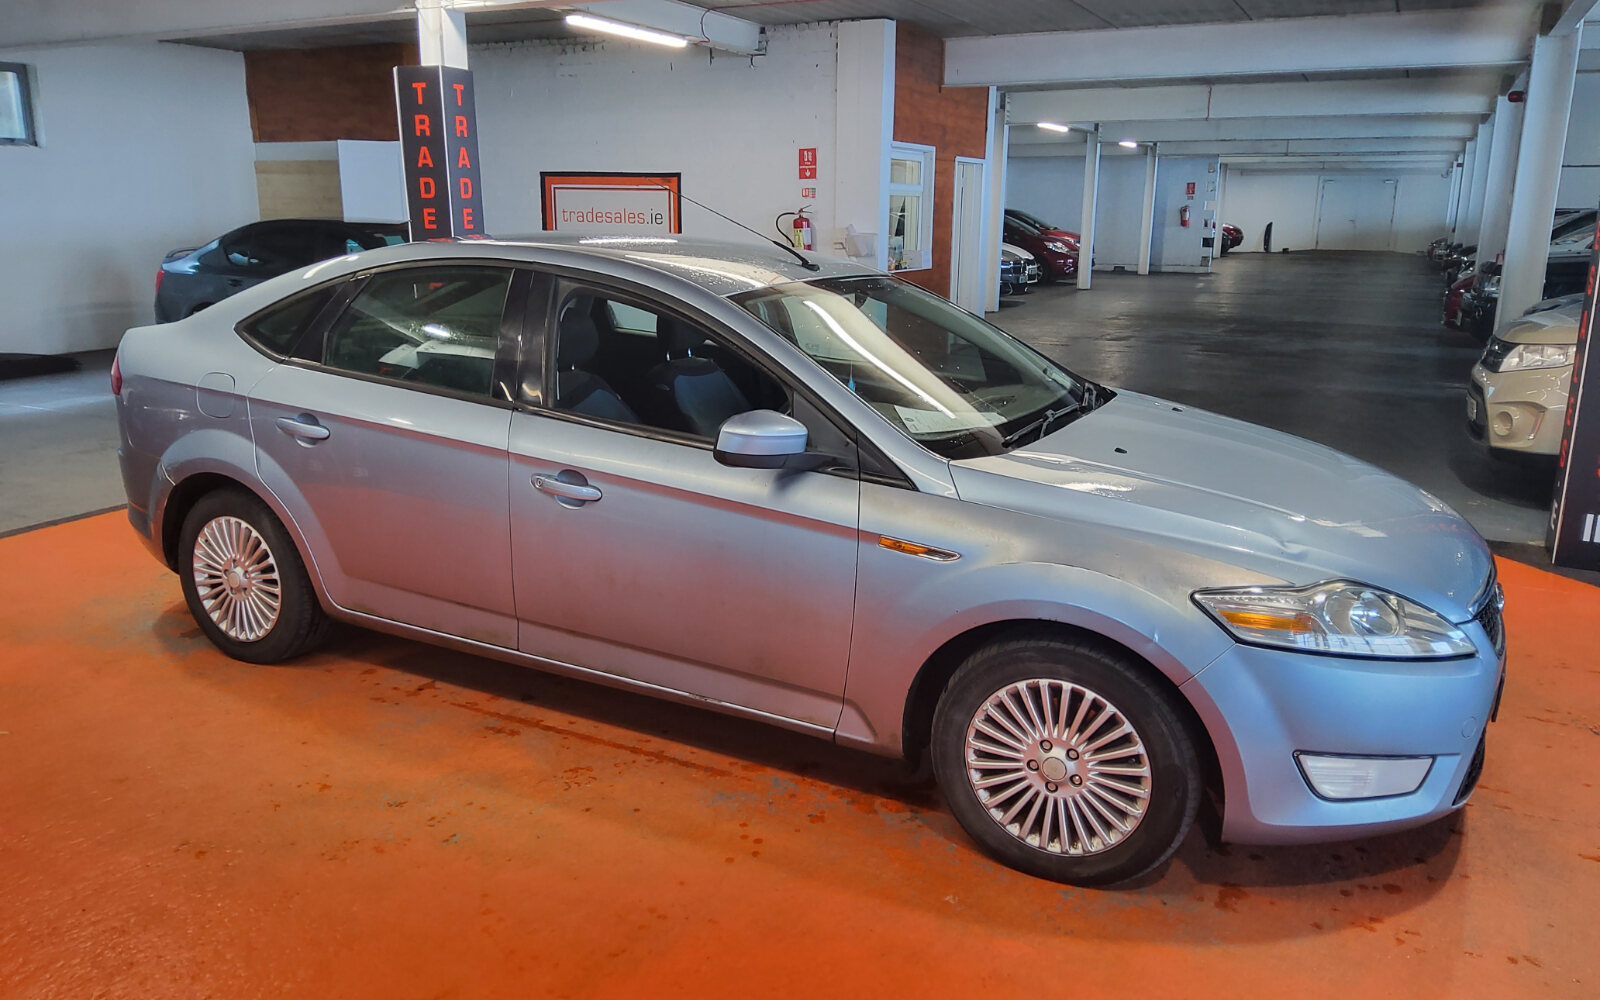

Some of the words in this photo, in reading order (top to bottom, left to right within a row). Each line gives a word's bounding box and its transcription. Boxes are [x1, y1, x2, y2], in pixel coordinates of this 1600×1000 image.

[412, 82, 437, 229] TRADE
[453, 84, 474, 229] TRADE
[562, 207, 664, 225] tradesales.ie
